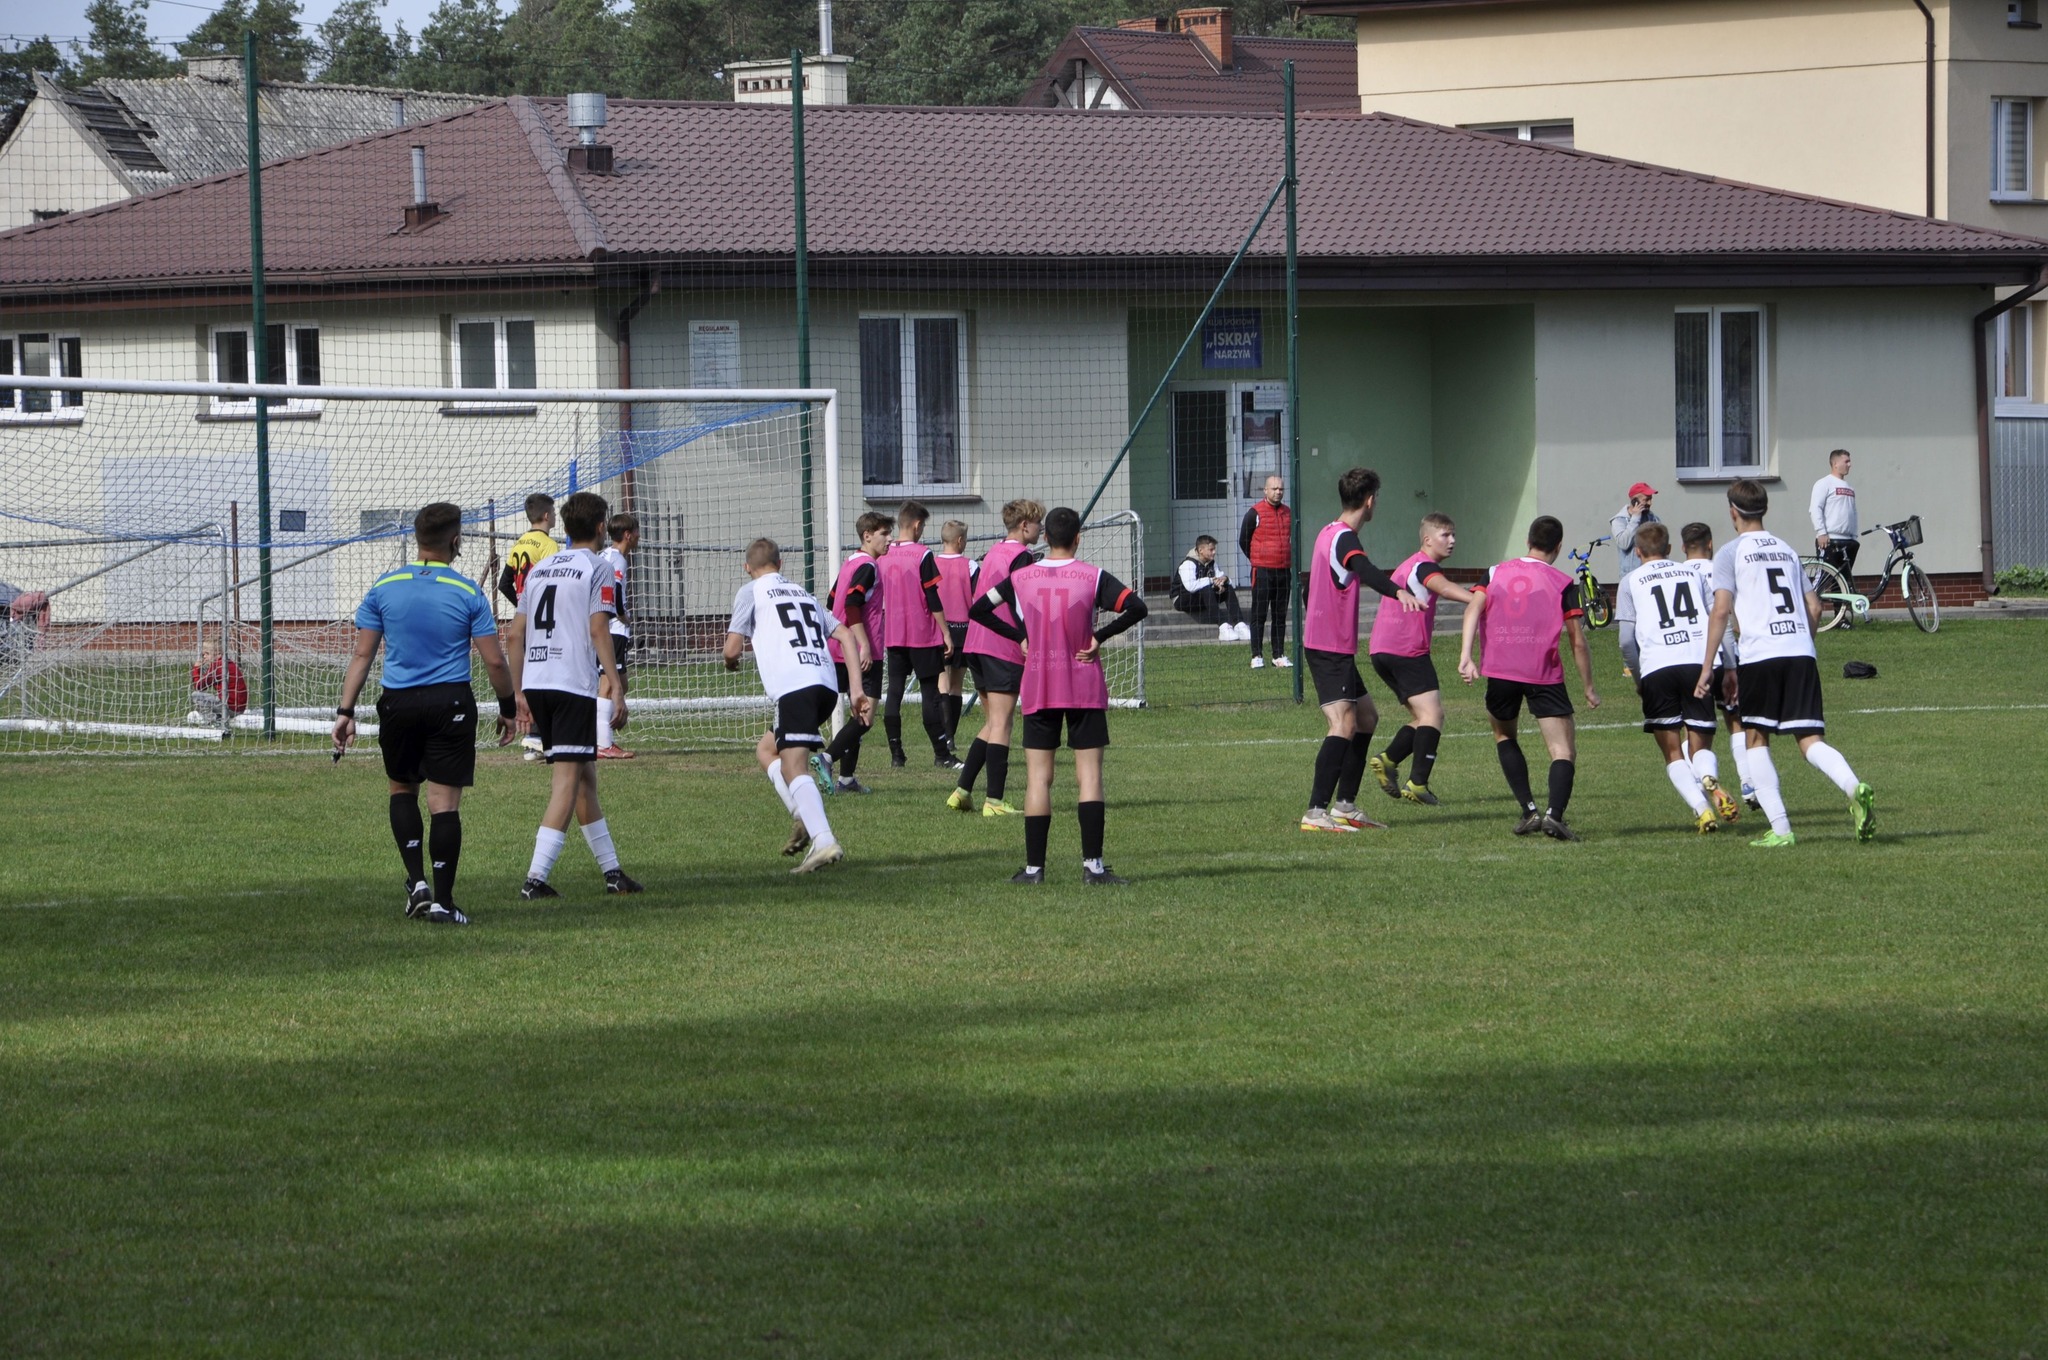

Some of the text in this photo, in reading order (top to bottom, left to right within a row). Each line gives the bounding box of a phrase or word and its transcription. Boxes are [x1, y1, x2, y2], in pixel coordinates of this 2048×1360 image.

[1208, 318, 1223, 326] KLUB
[1213, 349, 1251, 360] NARZYM
[1752, 537, 1778, 547] TSG
[1744, 552, 1768, 564] STOMIL
[552, 567, 584, 580] OLSZTYN
[1017, 568, 1058, 583] POLONIA
[1638, 572, 1664, 586] STOMIL
[1503, 575, 1534, 619] 8
[1766, 567, 1795, 615] 5
[534, 584, 558, 640] 4
[1037, 587, 1070, 622] 11
[1650, 581, 1699, 630] 14
[775, 601, 825, 650] 55
[1769, 620, 1797, 636] DBK
[1664, 630, 1691, 646] DBK
[528, 646, 548, 662] DBK
